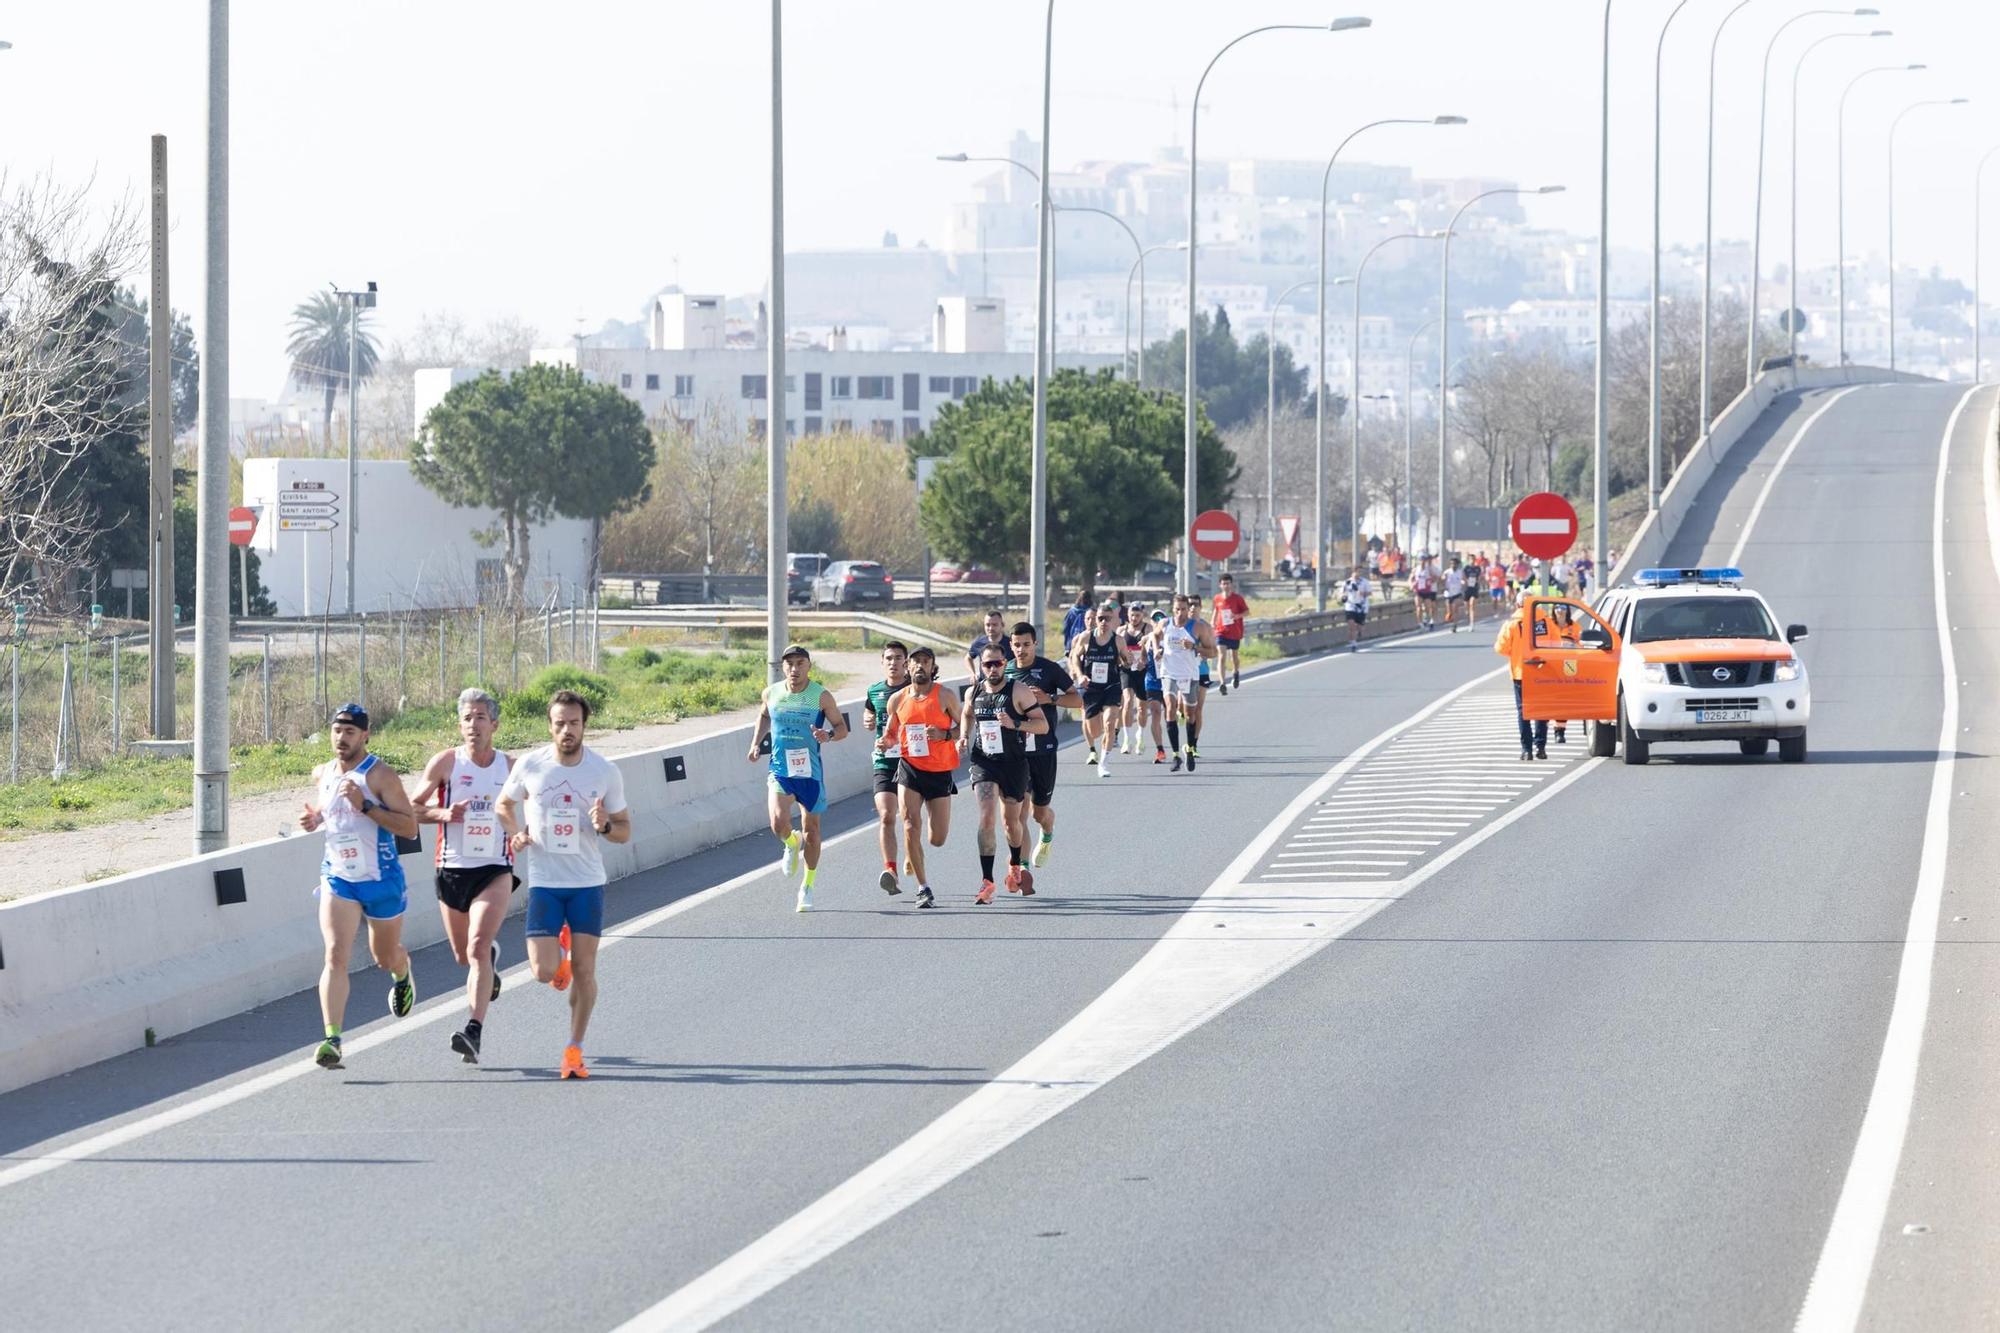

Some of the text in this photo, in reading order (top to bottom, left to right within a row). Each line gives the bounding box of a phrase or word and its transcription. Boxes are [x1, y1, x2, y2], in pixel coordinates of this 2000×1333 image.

[1704, 711, 1748, 720] 0262 JKT
[986, 732, 997, 741] 75
[791, 758, 806, 766] 137
[467, 826, 491, 835] 220
[554, 824, 573, 836] 89
